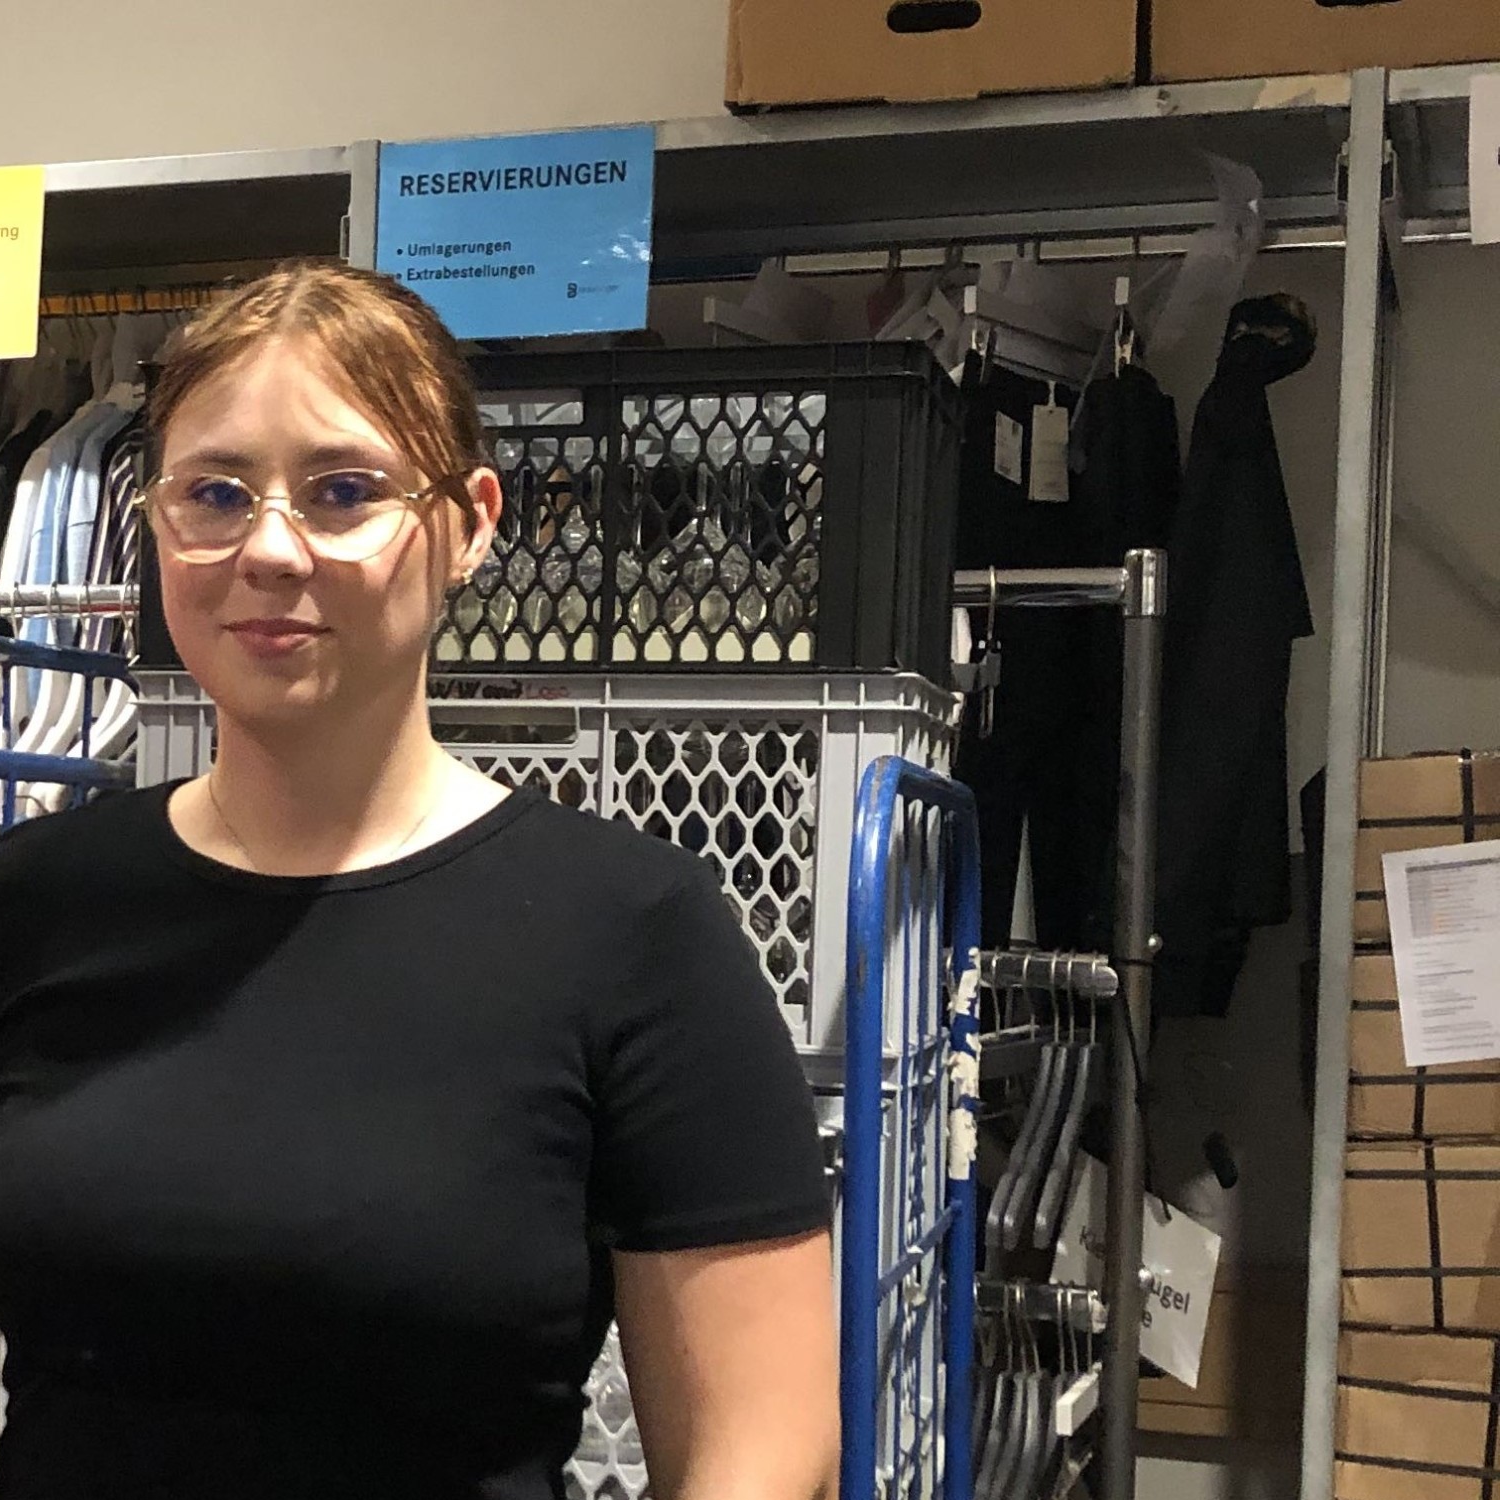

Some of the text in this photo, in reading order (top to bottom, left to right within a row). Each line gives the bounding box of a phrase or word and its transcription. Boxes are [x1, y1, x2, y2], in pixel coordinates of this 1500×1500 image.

[400, 160, 627, 197] RESERVIERUNGEN
[407, 239, 512, 258] Umlagerungen
[407, 262, 535, 282] Extrabestellungen
